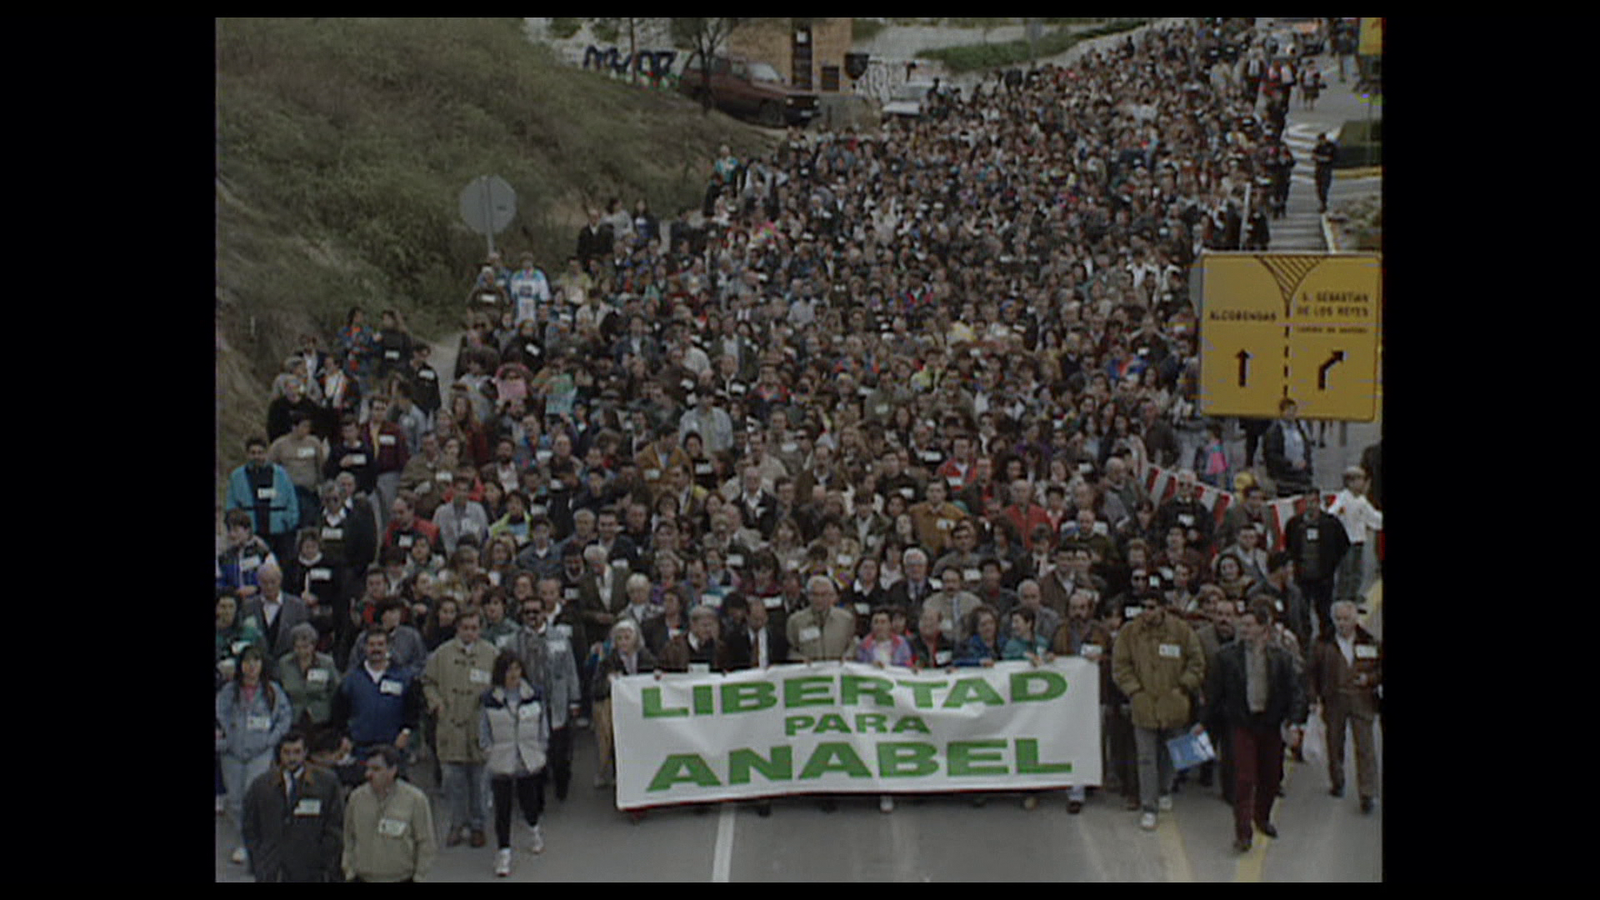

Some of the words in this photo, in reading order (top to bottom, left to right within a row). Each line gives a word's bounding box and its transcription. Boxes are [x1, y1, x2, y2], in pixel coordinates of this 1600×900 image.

[1209, 310, 1277, 322] ALCOBENDAS
[1297, 306, 1309, 316] DE
[1313, 306, 1333, 317] LOS
[1337, 306, 1369, 318] REYES
[642, 672, 1068, 719] LIBERTAD
[785, 713, 931, 736] PARA
[646, 738, 1073, 792] ANABEL
